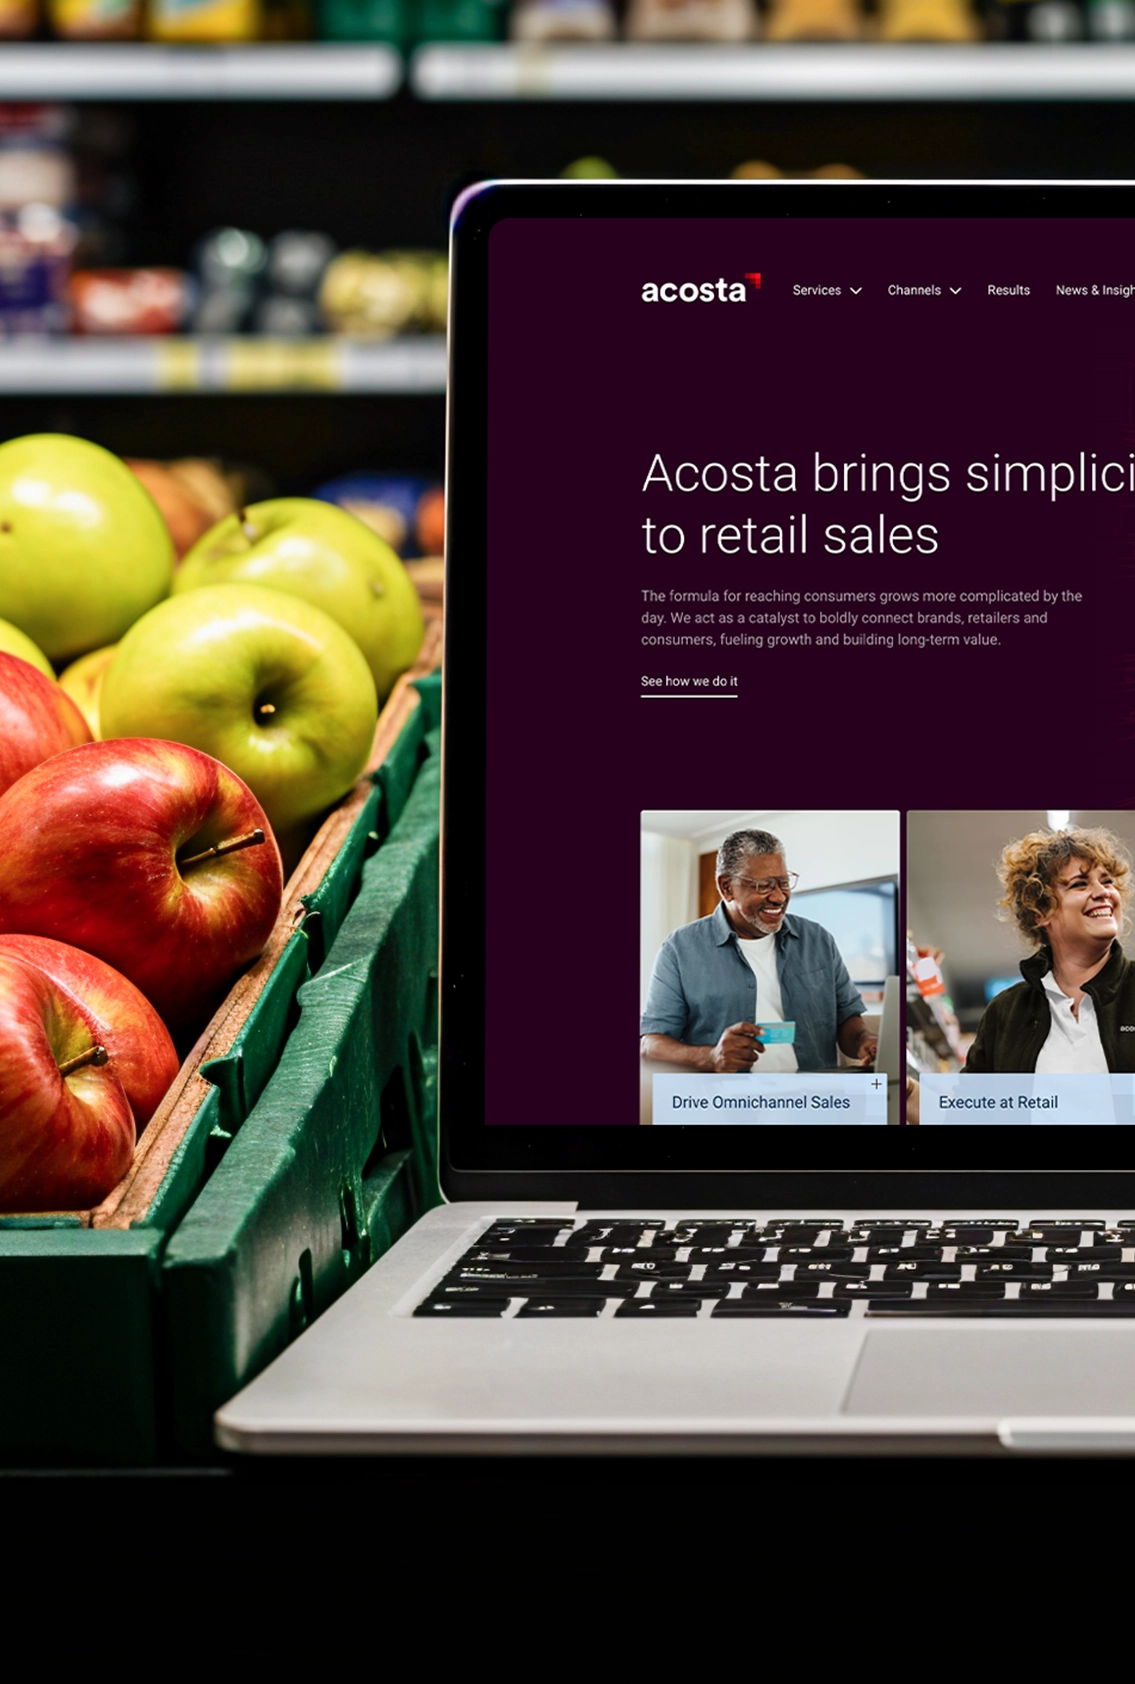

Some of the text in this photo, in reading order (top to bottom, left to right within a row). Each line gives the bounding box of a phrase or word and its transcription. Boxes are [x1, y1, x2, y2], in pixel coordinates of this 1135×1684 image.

[641, 277, 747, 303] acosta
[792, 284, 842, 296] Services
[887, 284, 942, 296] Channels
[987, 284, 1031, 296] Results
[1056, 284, 1089, 296] News
[1091, 284, 1100, 296] &
[641, 453, 797, 493] Acosta
[814, 451, 950, 503] brings
[641, 513, 939, 555] to retail sales
[641, 589, 1083, 606] The formula for reaching consumers grows more complicated by the
[641, 611, 1048, 627] day. We act as a catalyst to boldly connect brands, retailers and
[641, 632, 1001, 649] consumers, fueling growth and building long-term value.
[640, 675, 738, 687] See how we do it
[672, 1094, 851, 1109] Drive Omnichannel Sales
[939, 1095, 1058, 1109] Execute at Retail
